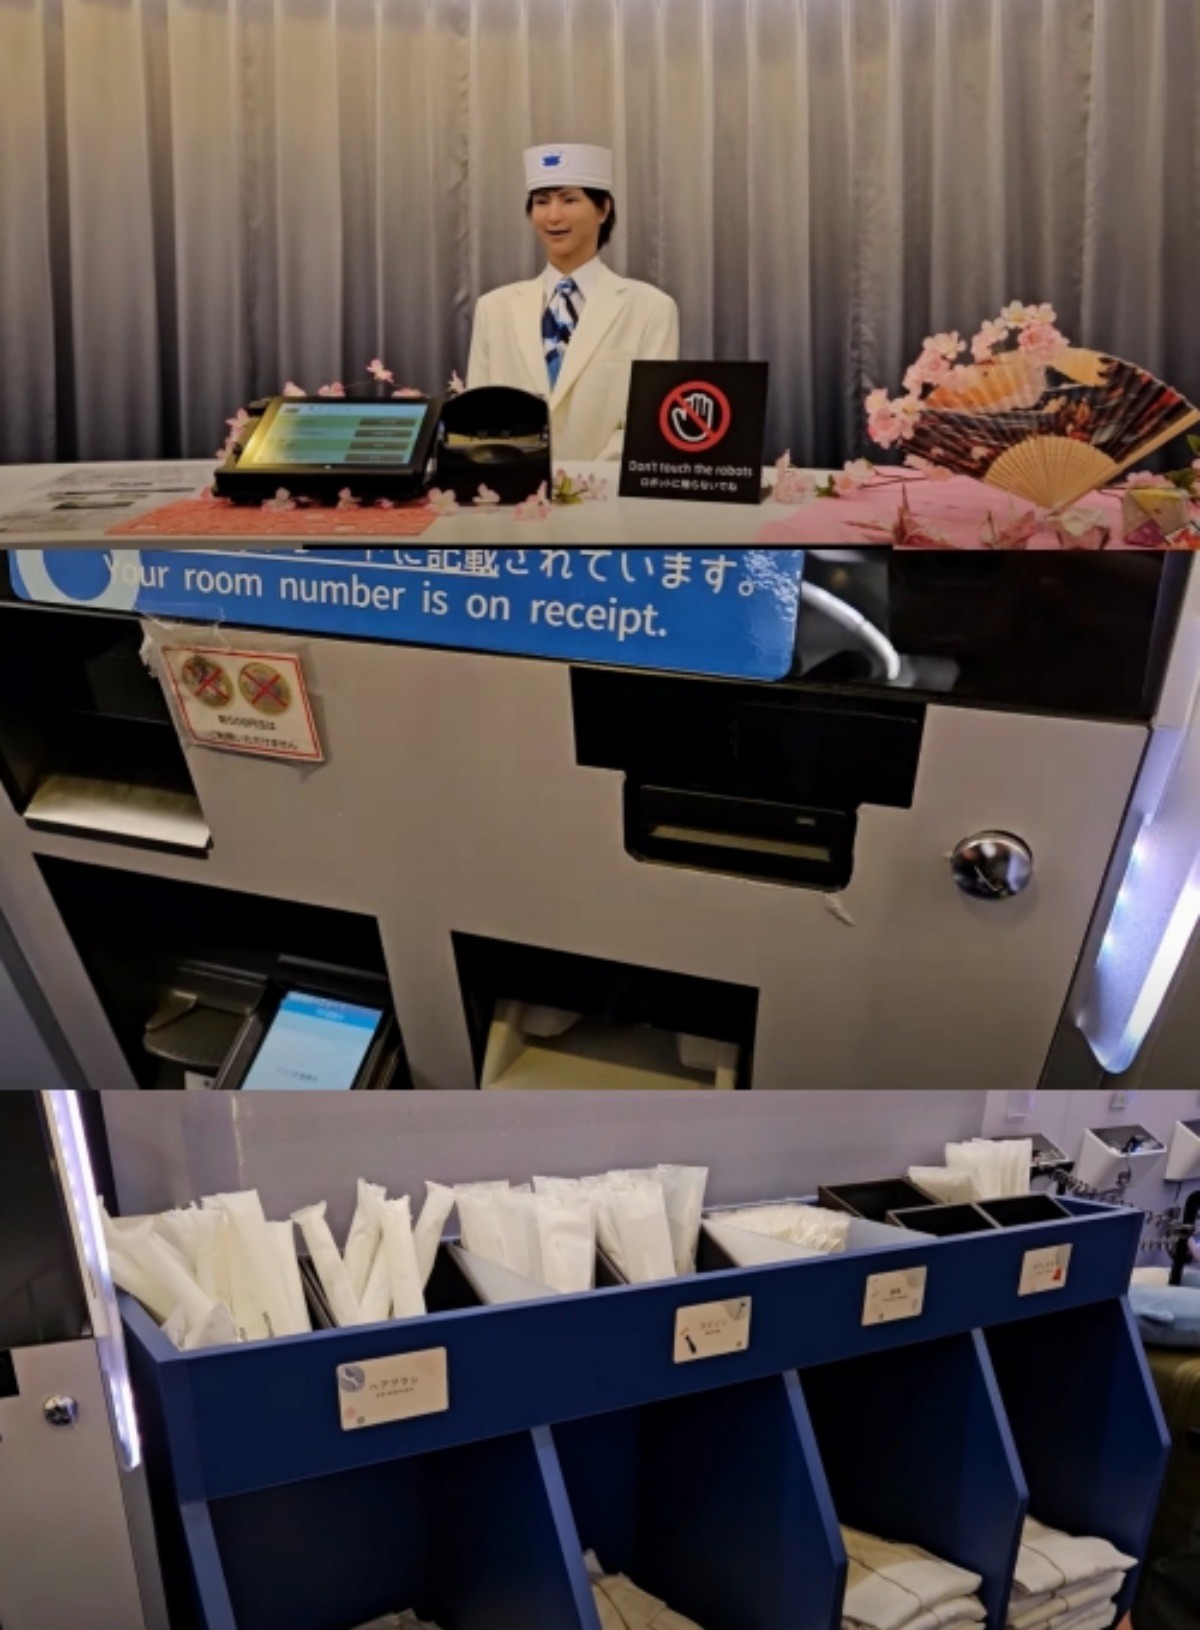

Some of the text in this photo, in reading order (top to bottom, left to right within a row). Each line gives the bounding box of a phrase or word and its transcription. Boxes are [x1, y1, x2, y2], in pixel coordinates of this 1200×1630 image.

[628, 460, 753, 478] Don't touch the robots
[184, 567, 263, 597] room
[279, 573, 406, 611] number
[422, 580, 449, 616] is
[466, 593, 510, 621] on
[530, 597, 667, 642] receipt.
